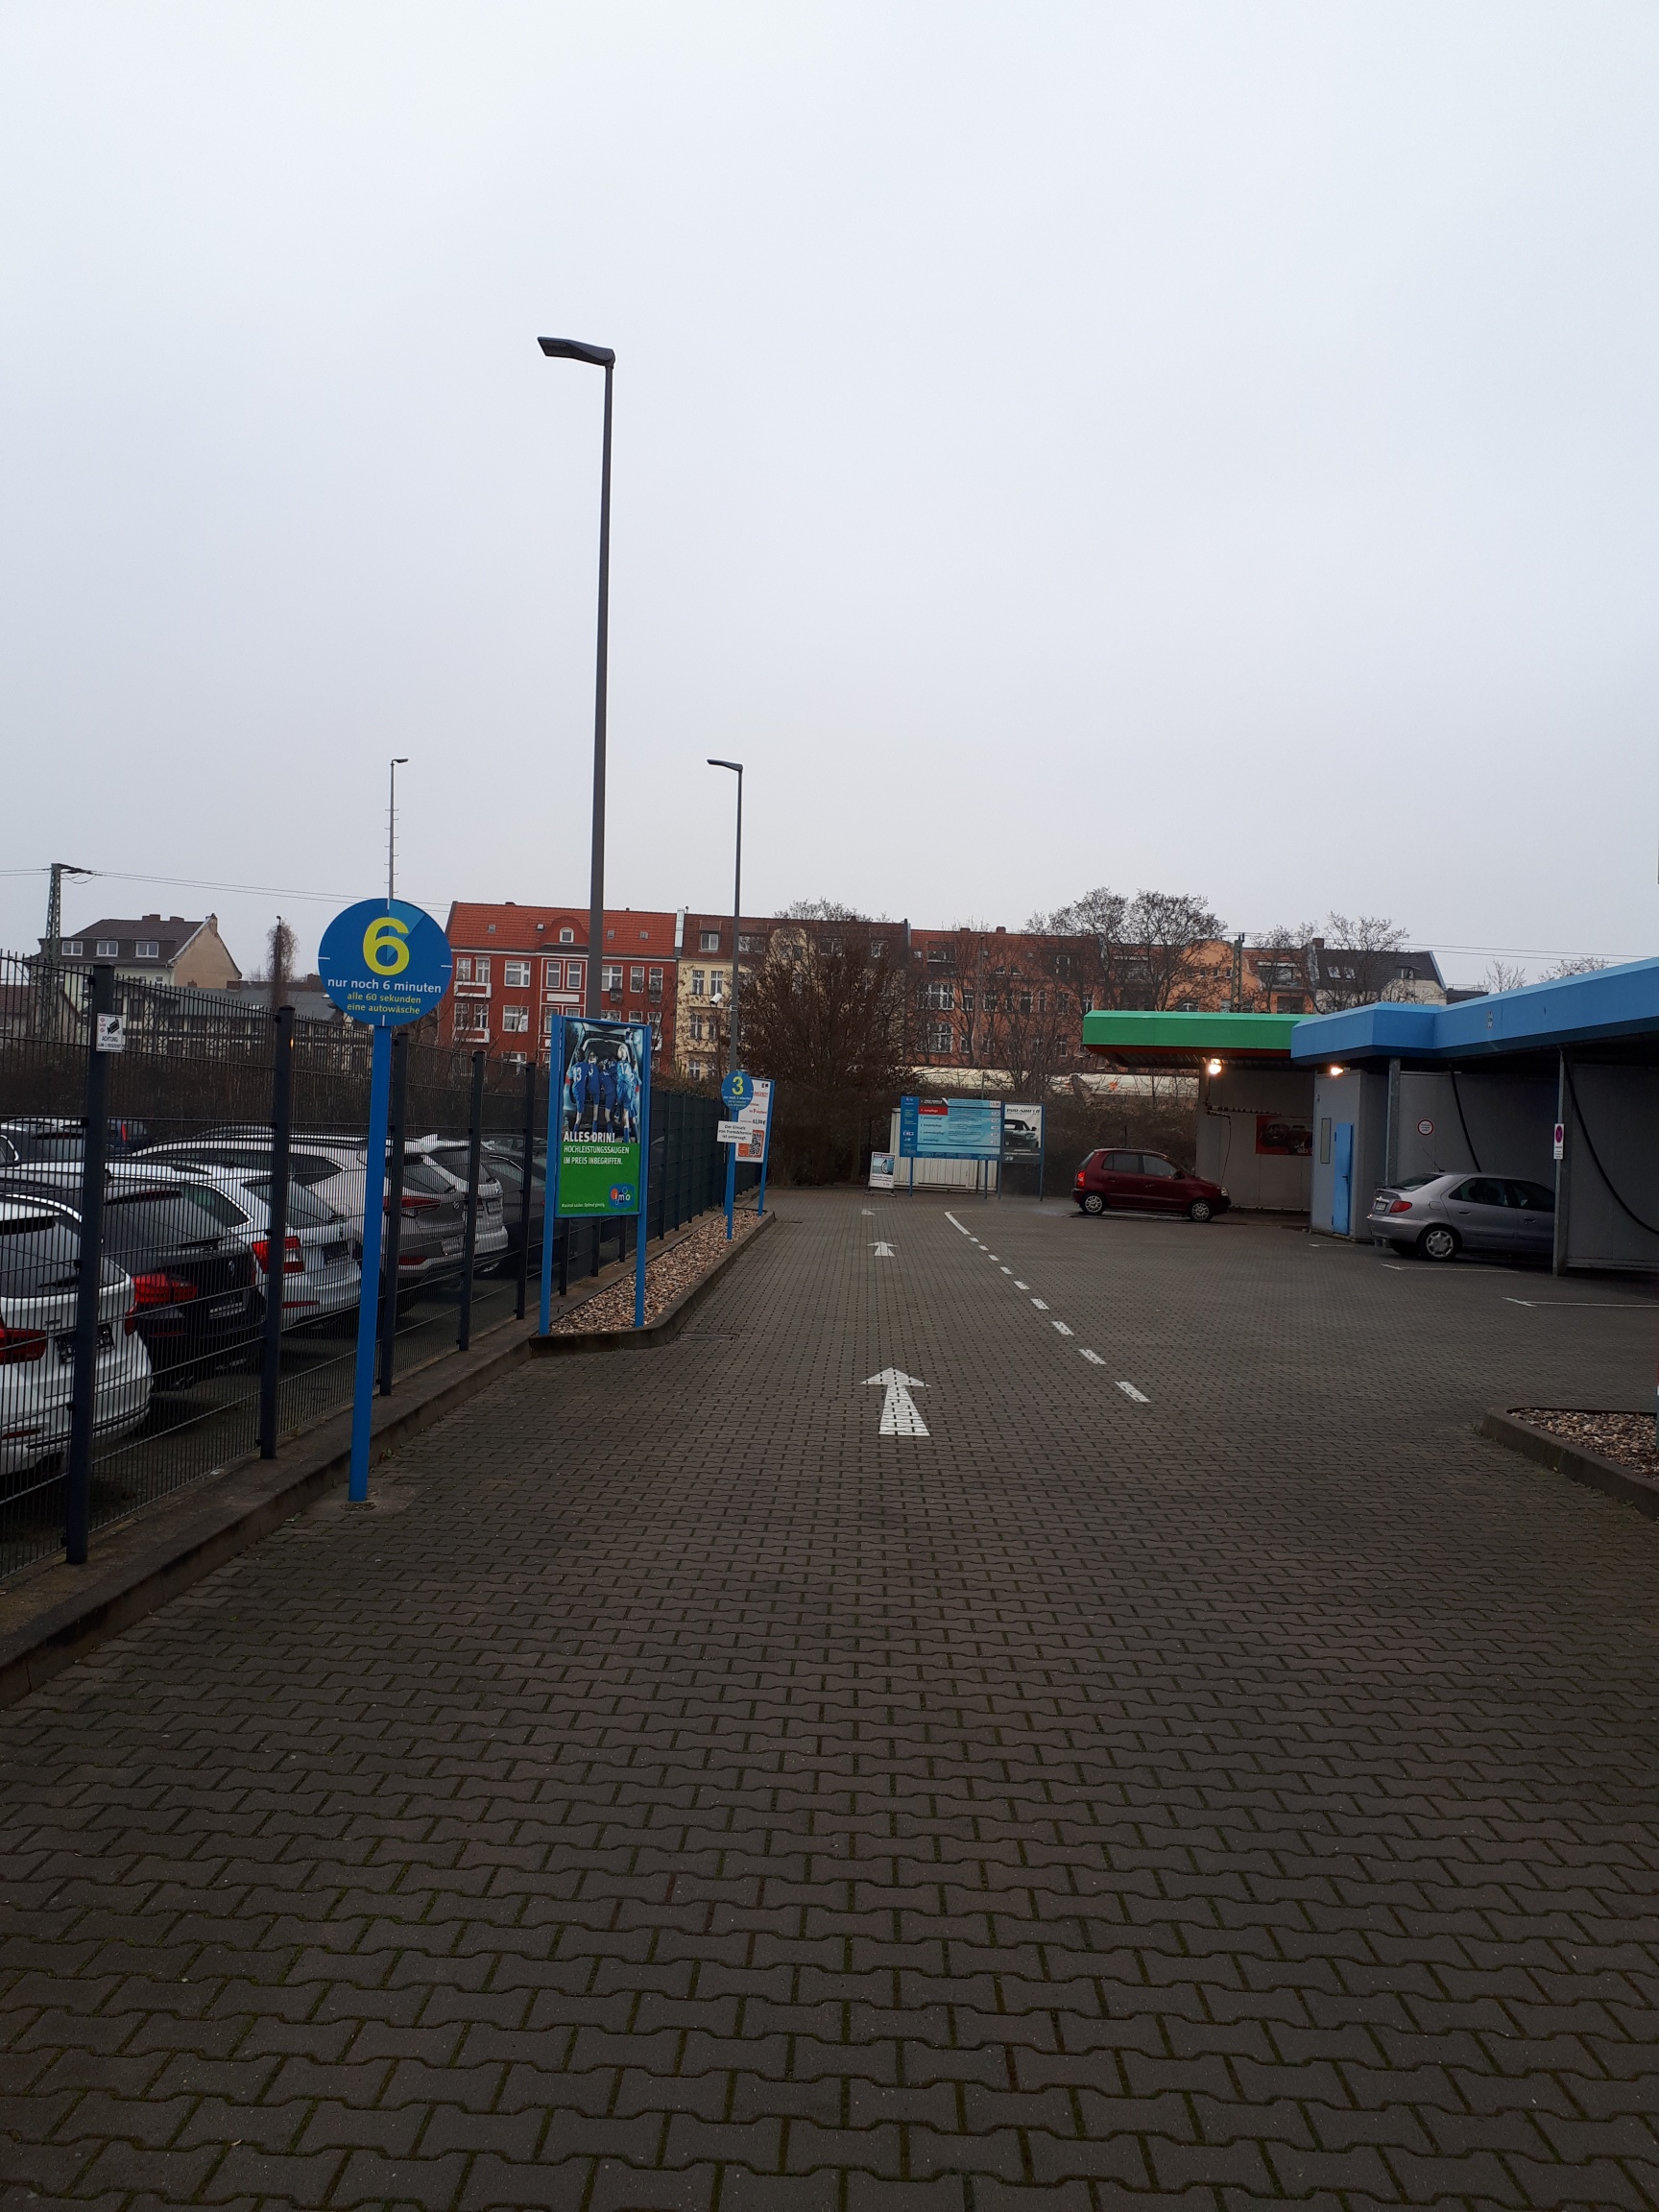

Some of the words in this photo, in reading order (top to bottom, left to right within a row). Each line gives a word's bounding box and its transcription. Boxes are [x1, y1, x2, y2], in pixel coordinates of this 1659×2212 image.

[363, 917, 410, 976] 6
[327, 978, 348, 988] nur
[350, 978, 378, 990] noch
[382, 979, 391, 990] 6
[394, 981, 442, 994] minuten
[347, 992, 363, 1000] alle
[366, 993, 377, 1001] 60
[379, 993, 421, 1004] sekunden
[347, 1002, 366, 1011] eine
[368, 1004, 421, 1015] autowäsche
[732, 1076, 744, 1095] 3
[564, 1131, 590, 1142] ALLES
[591, 1131, 616, 1143] DRIN!
[564, 1144, 630, 1154] HOCHLEISTUNGSSAUGEN
[563, 1156, 570, 1165] IM
[571, 1156, 588, 1165] PREIS
[614, 1192, 631, 1201] imo
